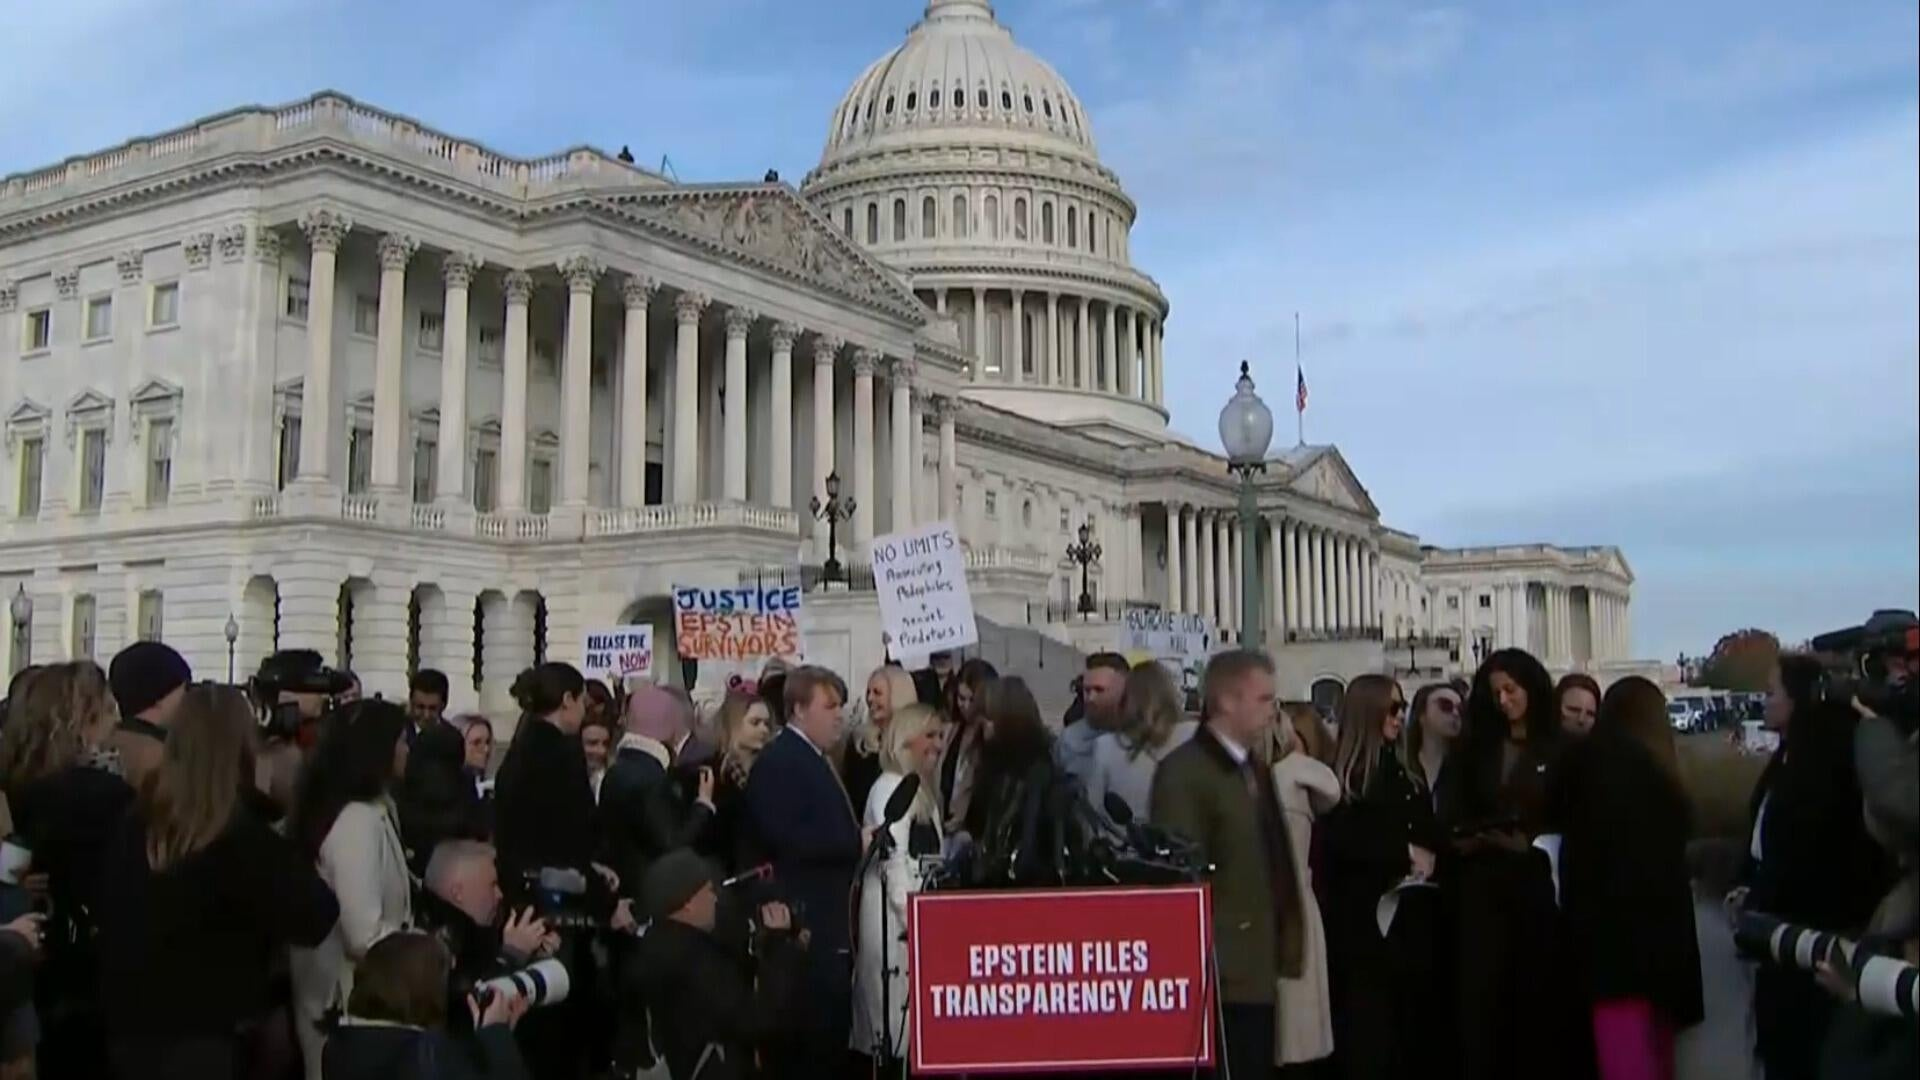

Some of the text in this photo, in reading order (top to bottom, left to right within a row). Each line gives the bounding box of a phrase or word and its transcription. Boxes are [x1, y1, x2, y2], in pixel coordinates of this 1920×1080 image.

[874, 530, 954, 564] NO LIMITS
[677, 586, 800, 613] JUSTICE
[680, 611, 797, 632] EPSTEIN
[587, 634, 646, 650] RELEASE THE
[678, 632, 797, 659] SURVIVORS
[586, 653, 612, 668] FILES
[969, 940, 1149, 978] EPSTEIN FILES
[930, 978, 1190, 1017] TRANSPARENCY ACT
